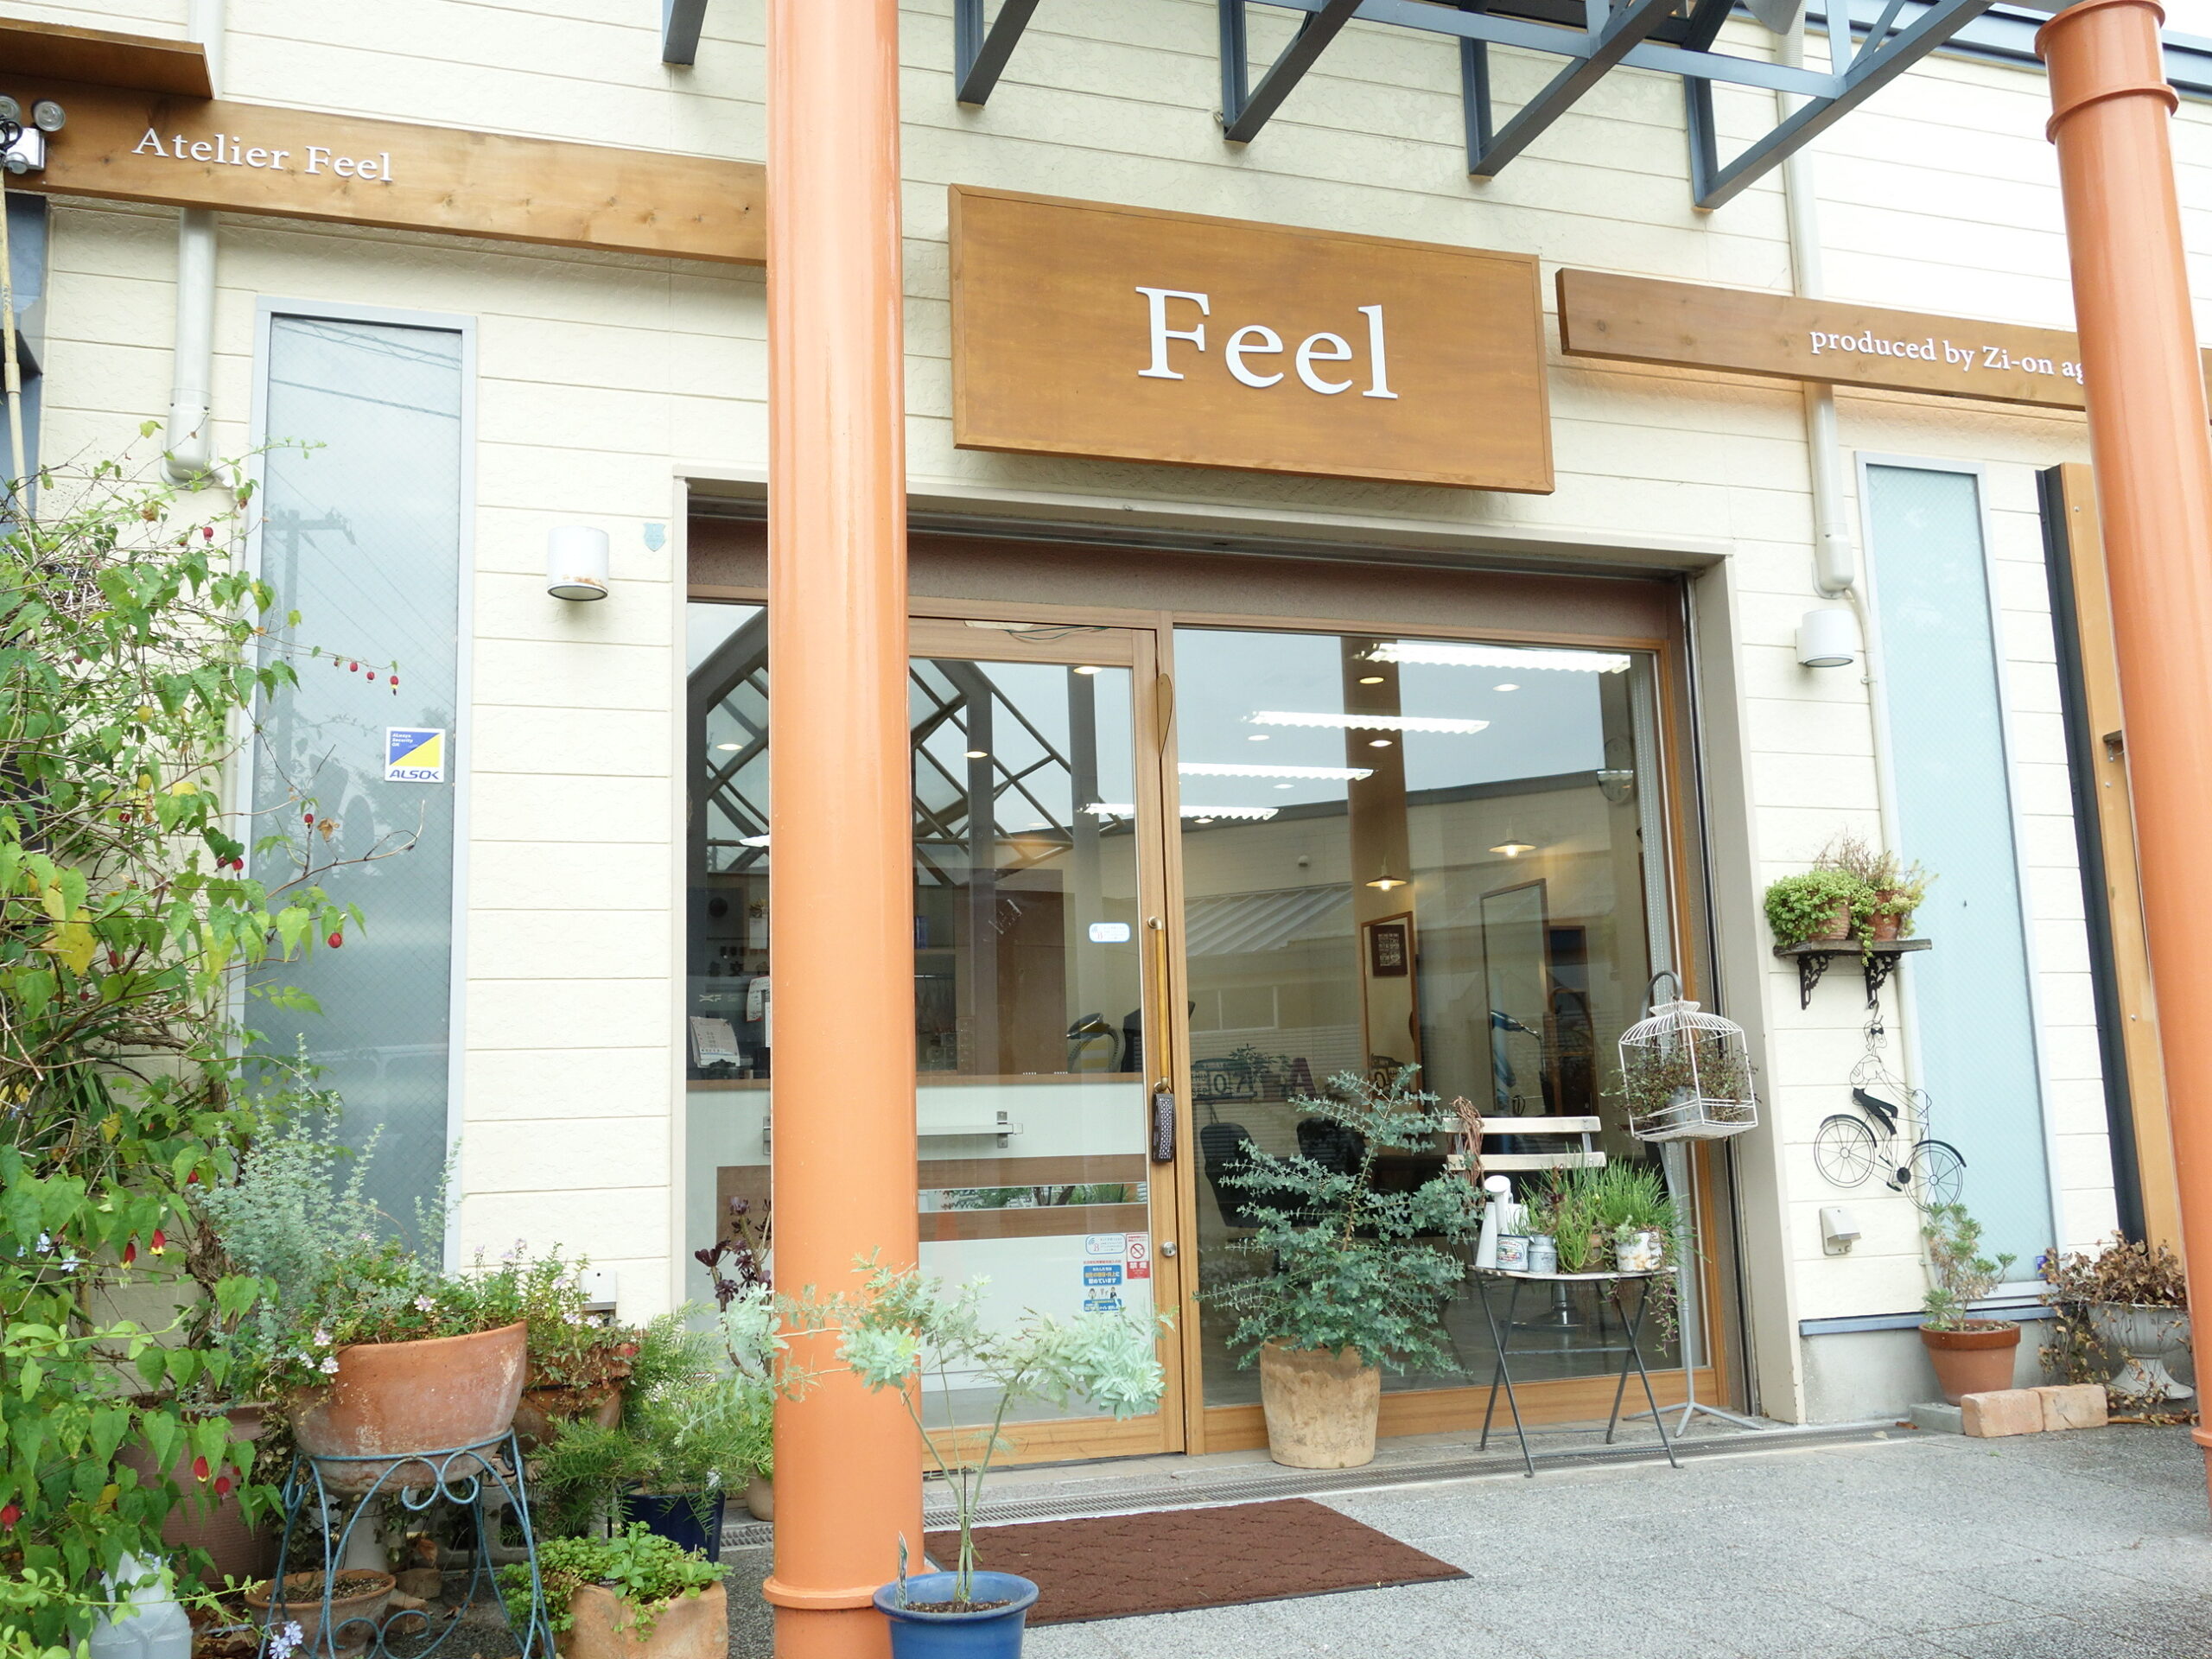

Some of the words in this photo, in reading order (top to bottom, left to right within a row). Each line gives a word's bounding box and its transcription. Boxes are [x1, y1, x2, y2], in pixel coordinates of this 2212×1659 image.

[131, 127, 292, 171] Atelier
[303, 144, 393, 183] Feel
[1135, 286, 1399, 399] Feel
[1808, 330, 1937, 361] produced
[1942, 340, 1975, 372] by
[1982, 345, 2056, 377] Zi-on
[389, 769, 440, 780] ALSOK
